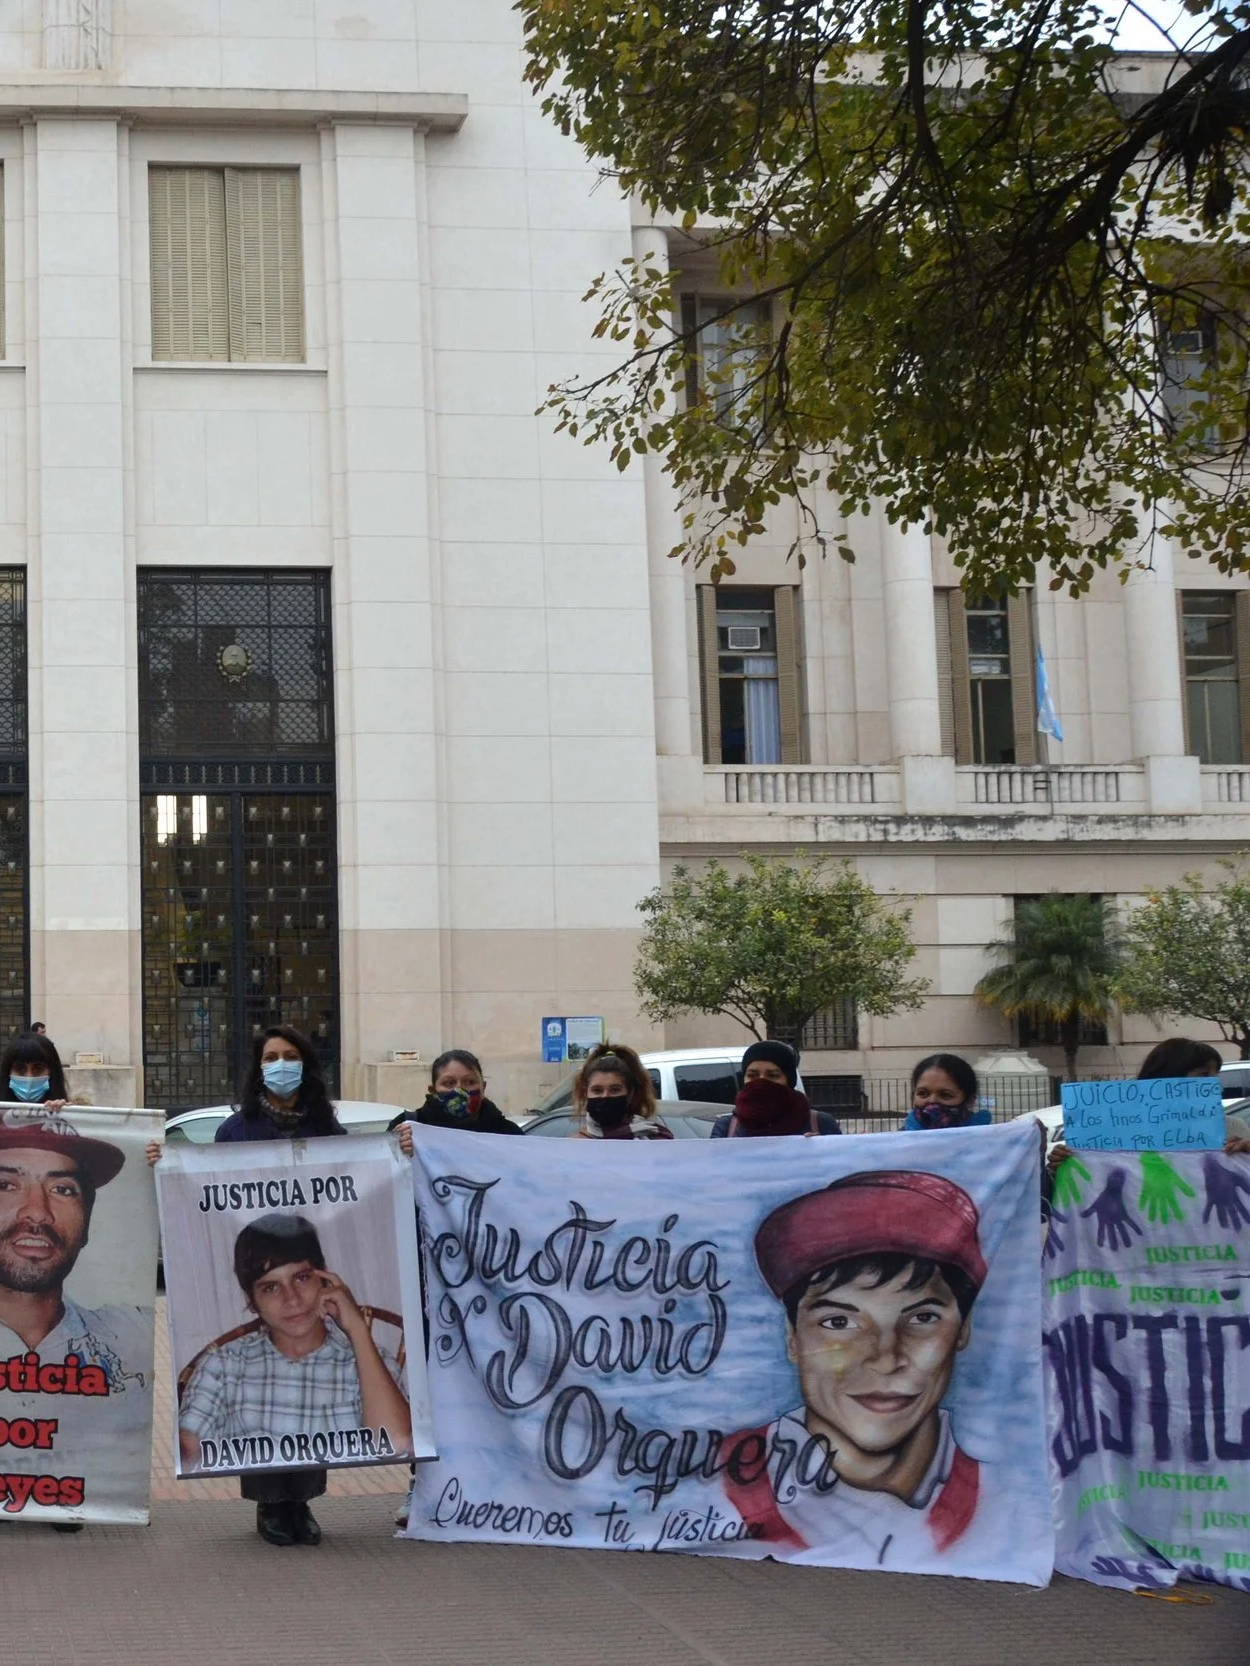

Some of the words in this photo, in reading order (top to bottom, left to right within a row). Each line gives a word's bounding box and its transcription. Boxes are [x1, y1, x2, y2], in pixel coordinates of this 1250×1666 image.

[1066, 1116, 1075, 1128] A
[1111, 1108, 1142, 1127] hnos
[199, 1178, 307, 1212] JUSTICIA
[310, 1175, 358, 1204] POR
[431, 1175, 731, 1294] Justicia
[1147, 1244, 1240, 1263] JUSTICIA
[1130, 1286, 1221, 1304] JUSTICIA
[485, 1291, 728, 1410] David
[200, 1433, 275, 1468] DAVID
[279, 1427, 395, 1463] ORQUERA
[544, 1385, 841, 1511] Orquera
[1138, 1471, 1230, 1491] JUSTICIA
[433, 1476, 574, 1540] Queremos
[596, 1500, 637, 1543] tu
